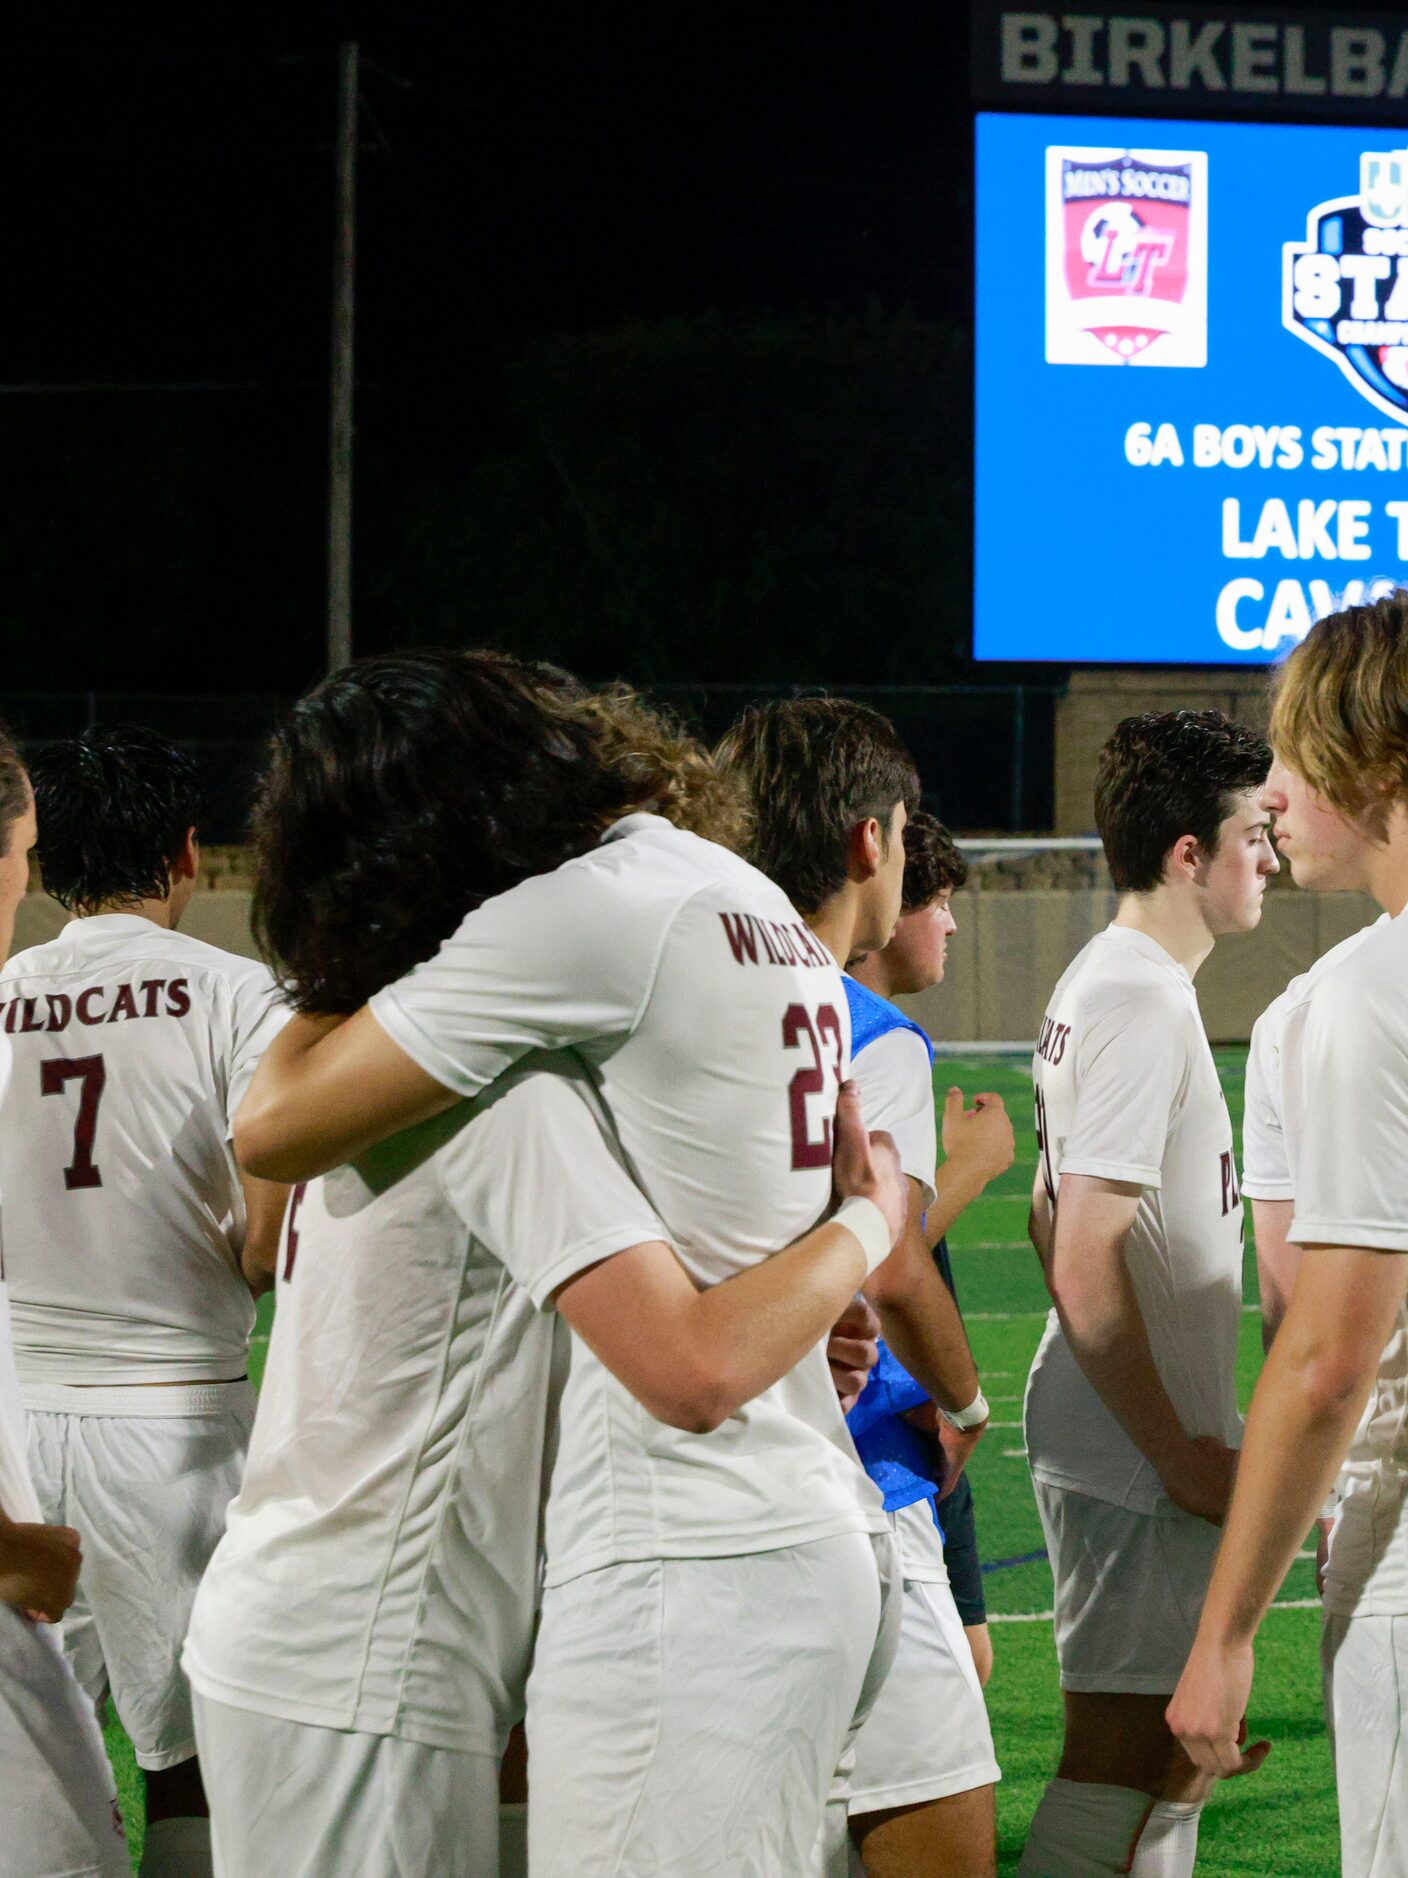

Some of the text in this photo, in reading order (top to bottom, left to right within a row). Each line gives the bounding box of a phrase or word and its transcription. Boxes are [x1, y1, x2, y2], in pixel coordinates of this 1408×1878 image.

[1124, 422, 1184, 467] 6A
[1193, 424, 1304, 469] BOYS
[1222, 498, 1372, 560] LAKE
[0, 978, 191, 1034] ILDCATS
[40, 1052, 106, 1190] 7
